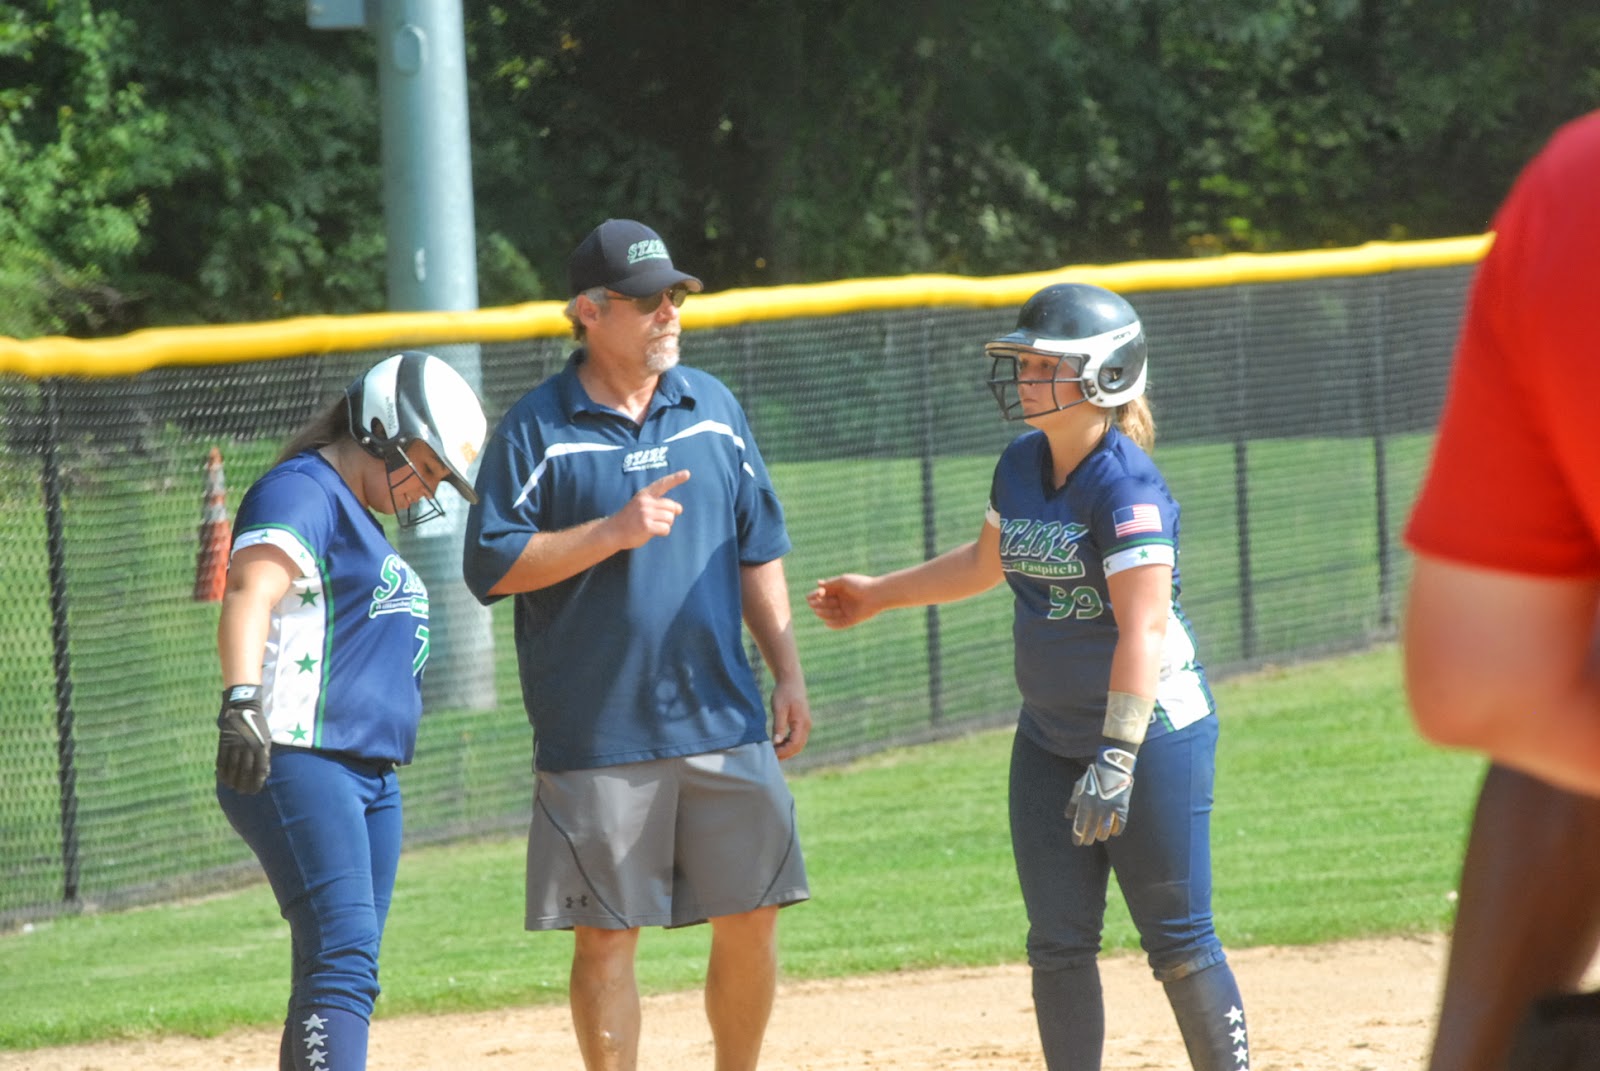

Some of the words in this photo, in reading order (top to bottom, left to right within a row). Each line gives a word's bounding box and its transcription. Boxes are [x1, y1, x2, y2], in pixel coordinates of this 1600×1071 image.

[1000, 518, 1089, 562] TARZ
[1020, 560, 1078, 576] Fastpitch
[1047, 585, 1104, 620] 99
